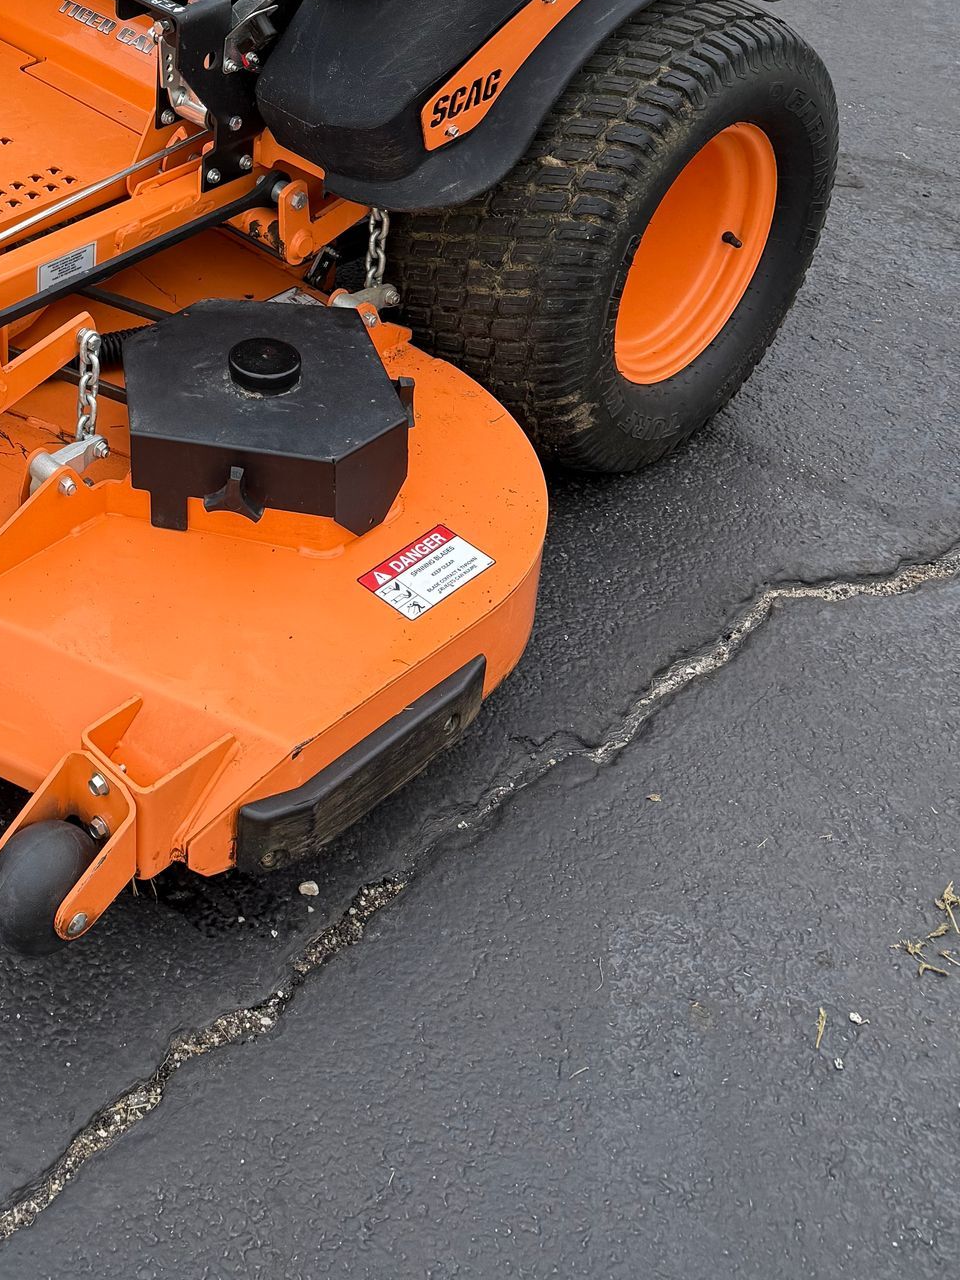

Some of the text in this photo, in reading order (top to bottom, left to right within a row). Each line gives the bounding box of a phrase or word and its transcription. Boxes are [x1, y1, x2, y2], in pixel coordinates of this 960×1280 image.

[430, 68, 502, 128] SCAG
[388, 533, 447, 572] DANGER
[410, 545, 455, 577] SPINNING BLADES
